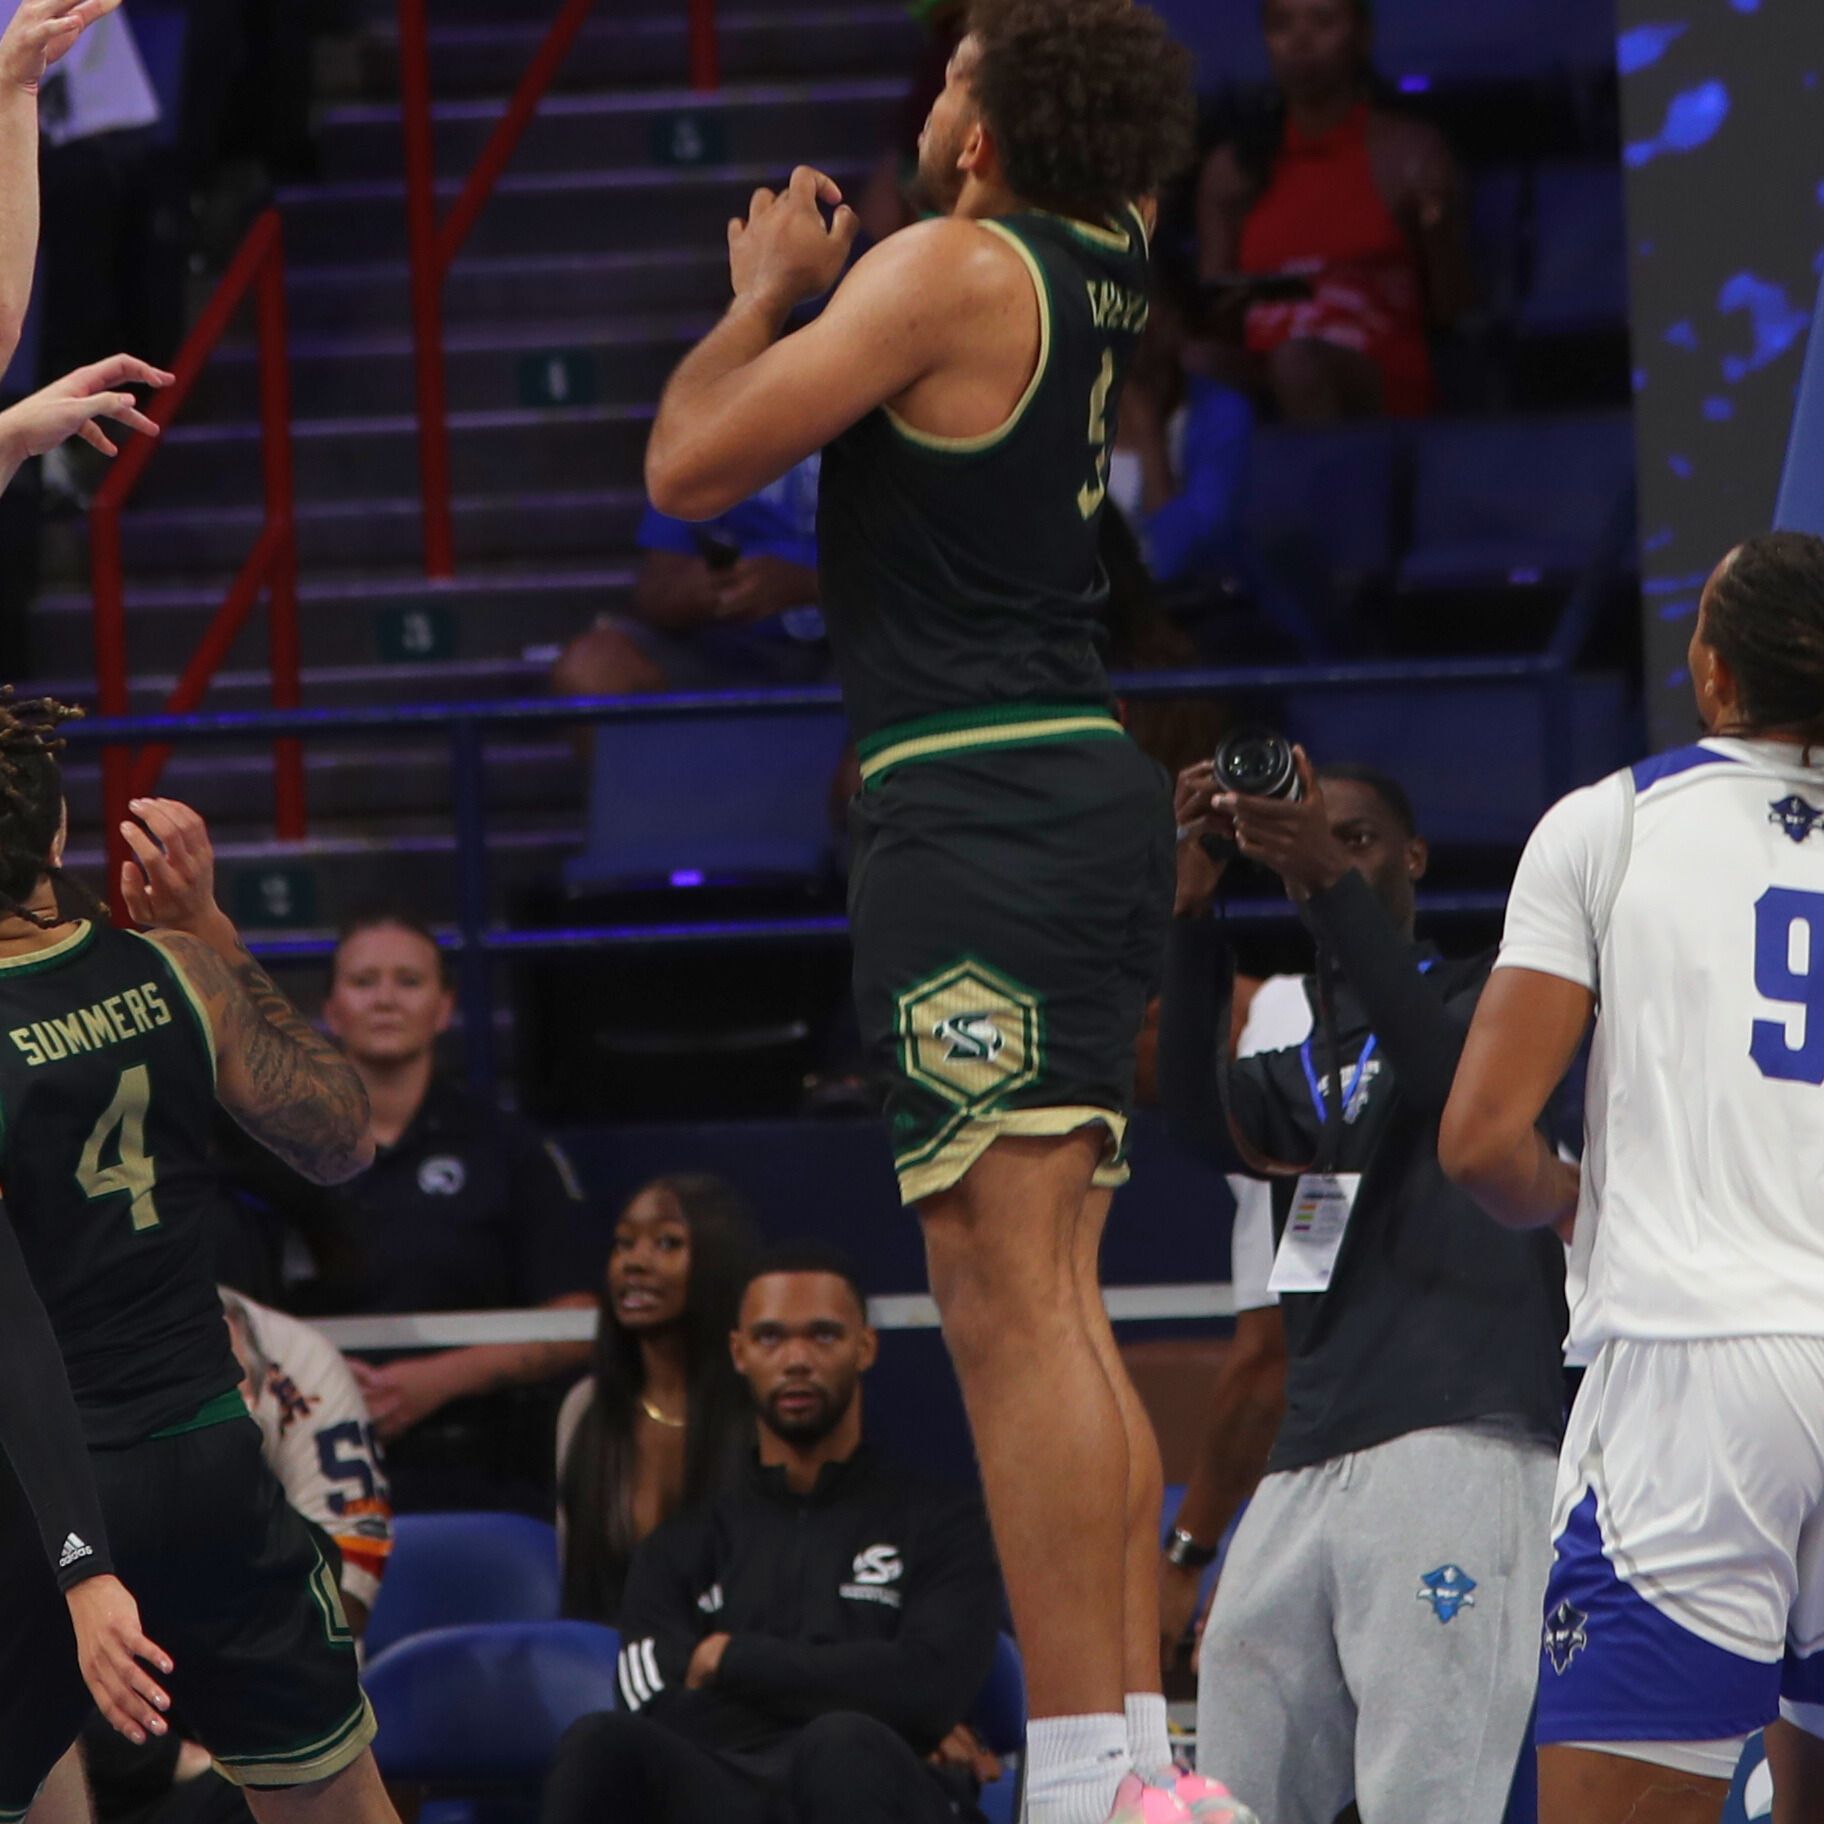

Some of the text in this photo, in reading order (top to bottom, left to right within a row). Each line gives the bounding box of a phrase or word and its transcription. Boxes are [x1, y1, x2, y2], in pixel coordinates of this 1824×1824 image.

[8, 980, 173, 1067] SUMMERS
[74, 1062, 162, 1233] 4
[58, 1544, 94, 1568] adidas
